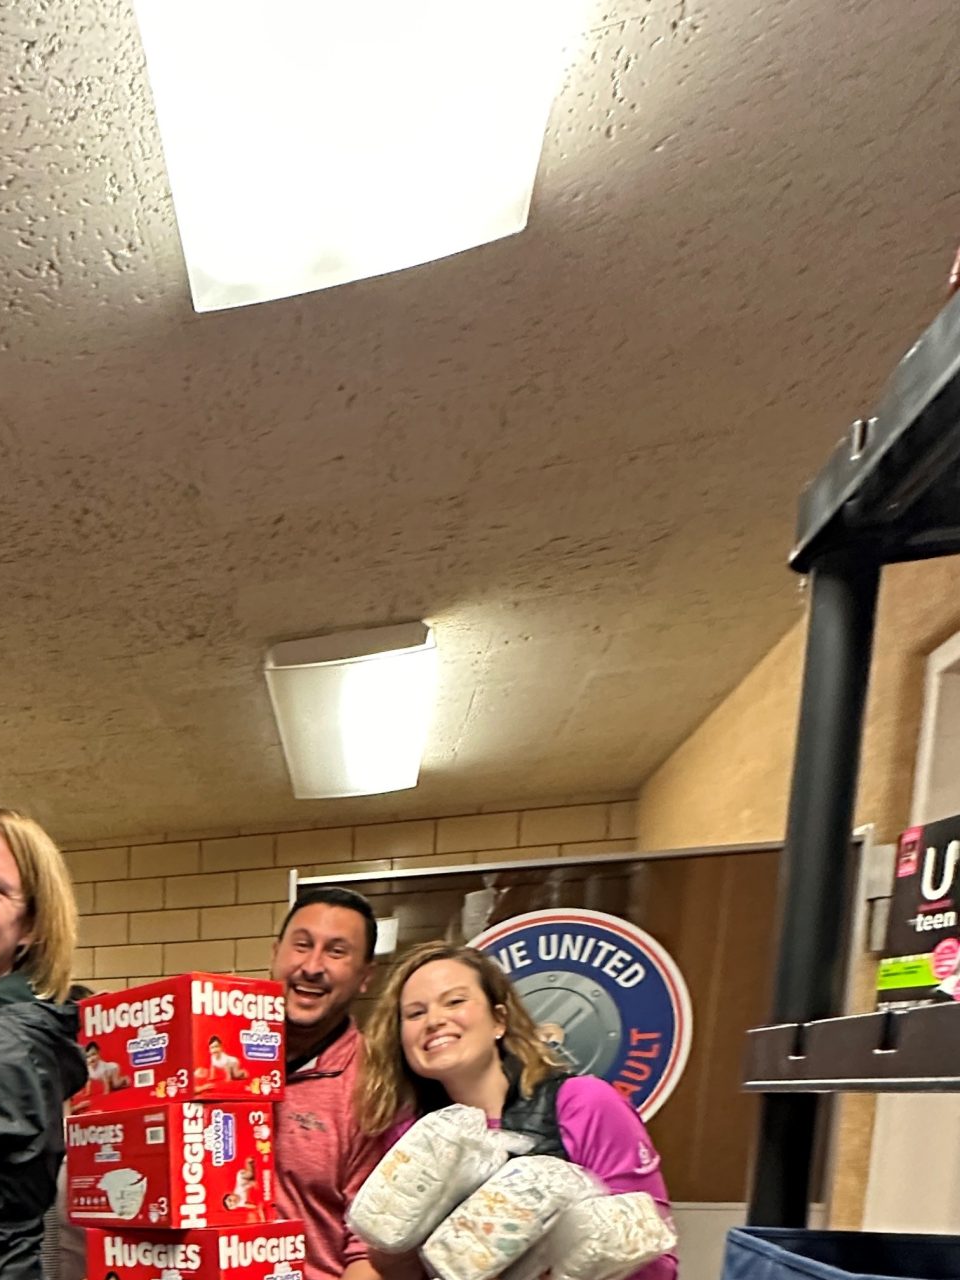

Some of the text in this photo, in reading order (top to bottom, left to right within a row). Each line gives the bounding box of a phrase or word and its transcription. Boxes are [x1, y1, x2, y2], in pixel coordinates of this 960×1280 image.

[915, 911, 957, 932] teen
[493, 934, 646, 989] VE UNITED
[85, 993, 175, 1037] HUGGIES
[191, 980, 285, 1022] HUGGIES
[128, 1035, 167, 1050] movers
[242, 1032, 279, 1044] movers
[177, 1069, 189, 1088] 3
[271, 1070, 281, 1088] 3
[611, 1028, 662, 1102] AULT
[249, 1111, 263, 1124] 3
[69, 1123, 124, 1146] HUGGIES
[213, 1111, 222, 1164] movers
[180, 1103, 207, 1228] HUGGIES
[158, 1197, 168, 1215] 3
[104, 1236, 202, 1270] HUGGIES
[219, 1234, 306, 1270] HUGGIES
